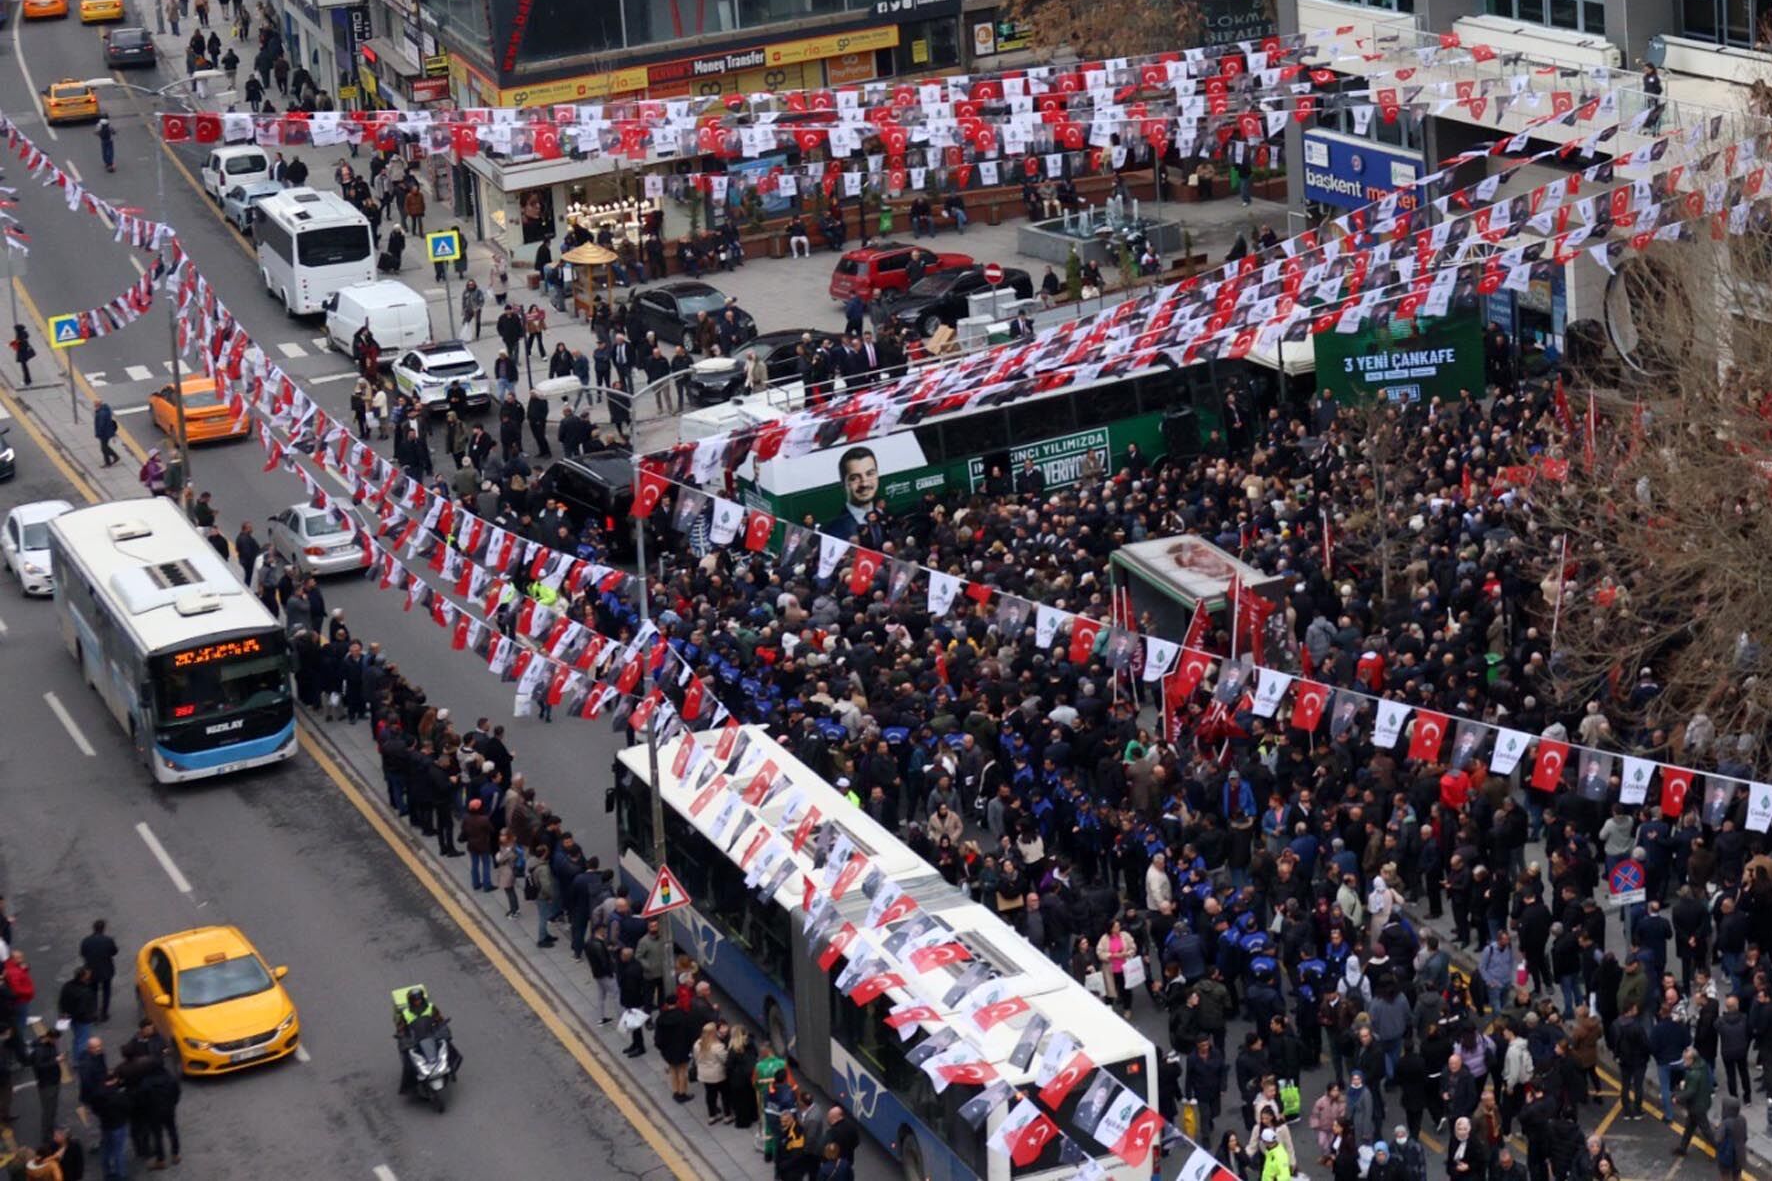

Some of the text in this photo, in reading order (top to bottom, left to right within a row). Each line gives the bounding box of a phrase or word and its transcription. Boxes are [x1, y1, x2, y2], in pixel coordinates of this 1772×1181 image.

[694, 59, 726, 74] Money
[727, 50, 765, 69] Transfer
[1306, 168, 1362, 197] başkent
[1344, 348, 1456, 372] 3 YENİ ÇANKAFE
[1041, 433, 1104, 456] YILIMIZDA
